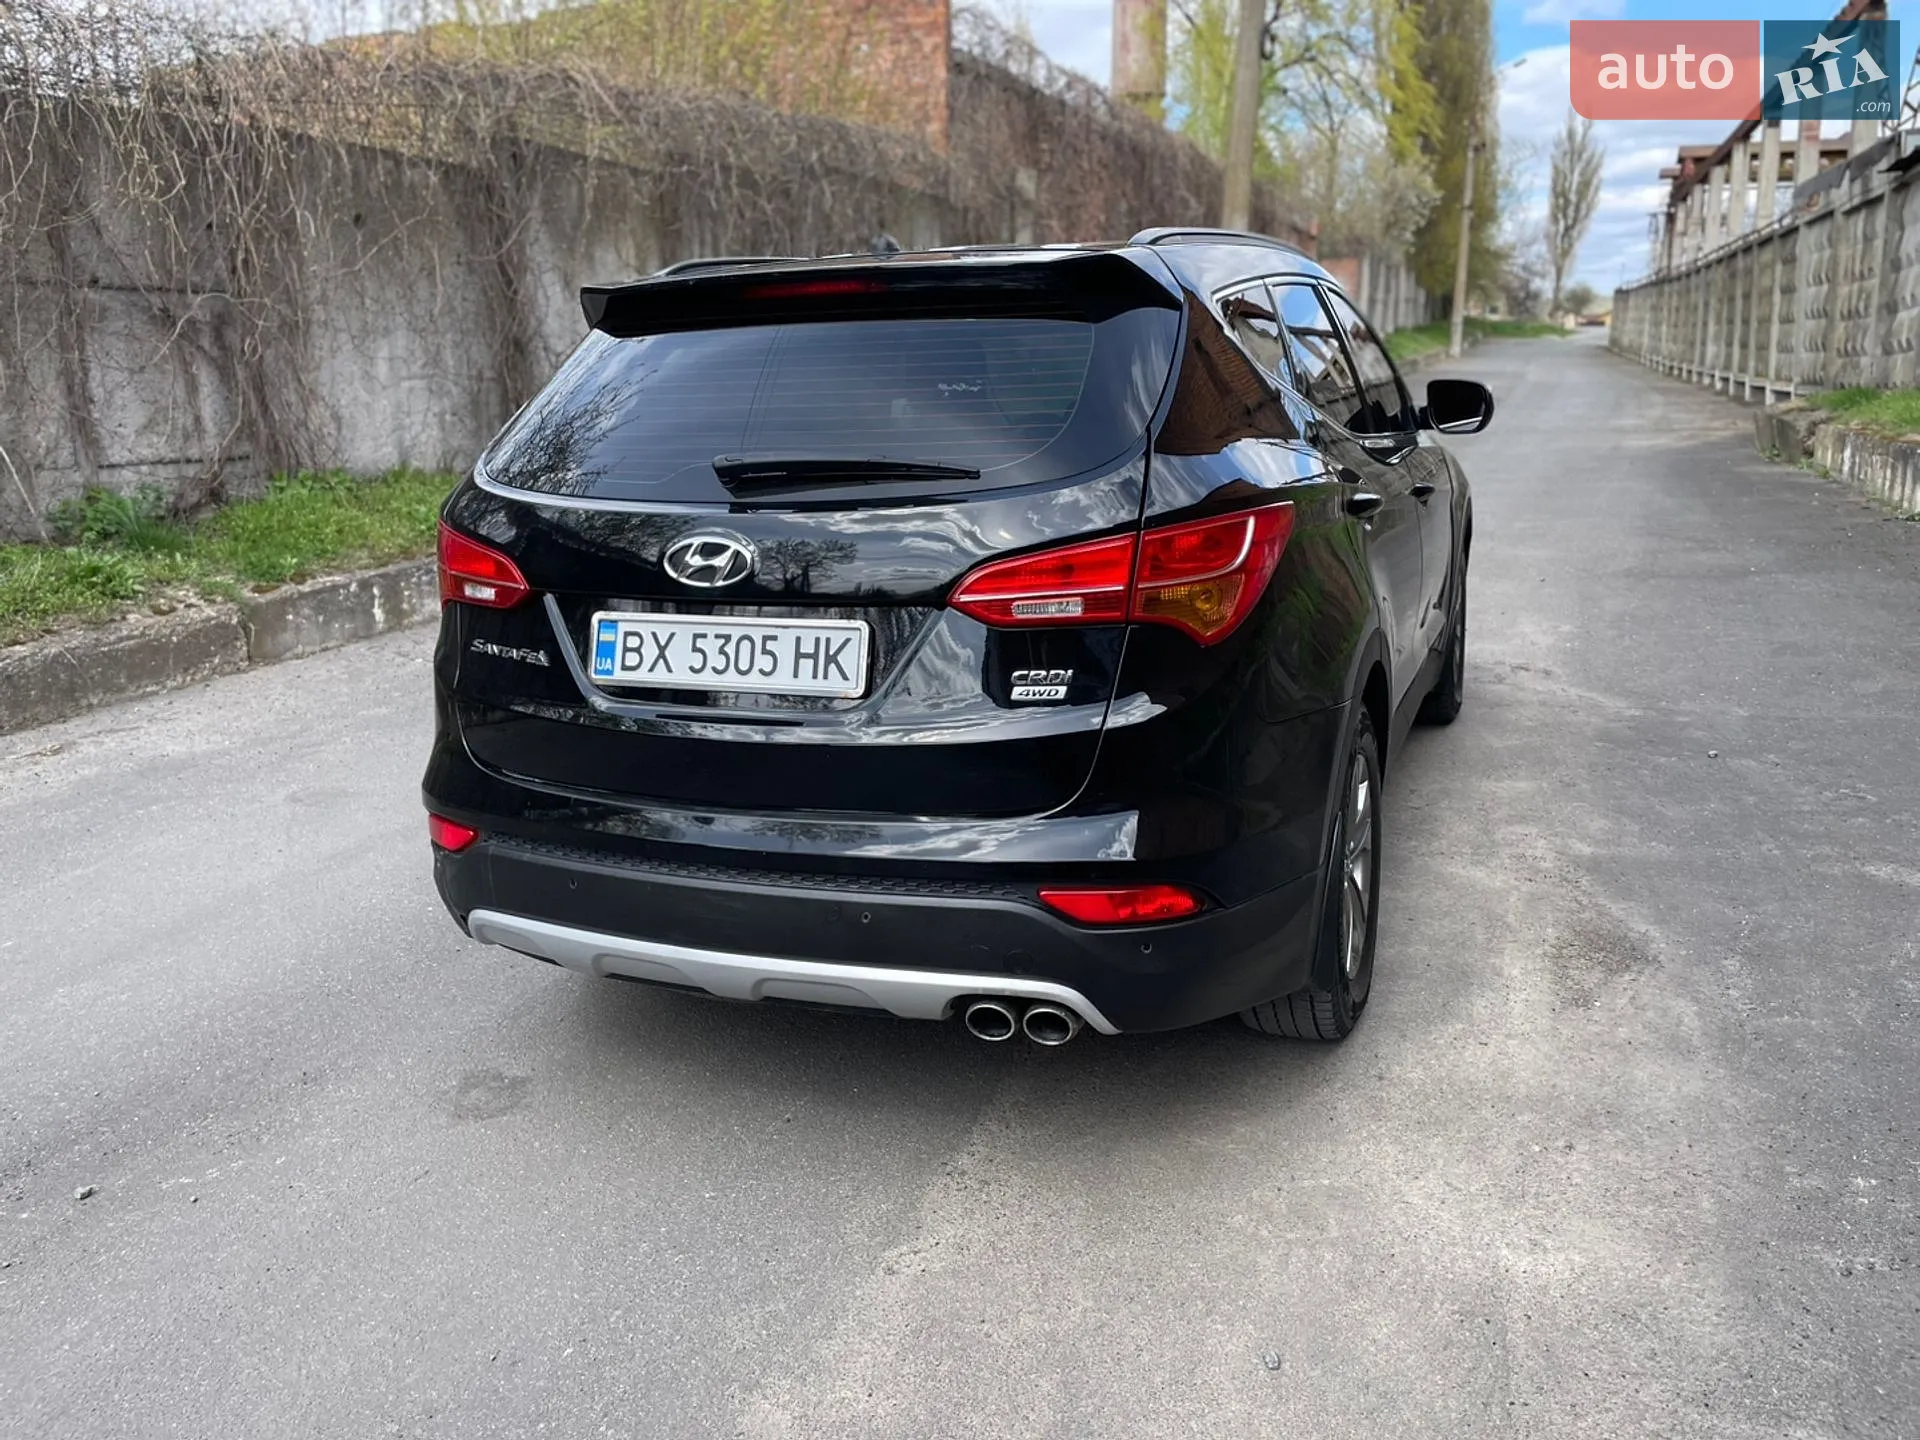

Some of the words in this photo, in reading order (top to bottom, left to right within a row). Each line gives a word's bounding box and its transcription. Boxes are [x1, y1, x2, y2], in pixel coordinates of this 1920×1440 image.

[620, 630, 677, 674] BX
[688, 632, 779, 677] 5305
[793, 635, 853, 681] HK
[596, 657, 613, 671] UA
[1018, 688, 1060, 698] 4WD
